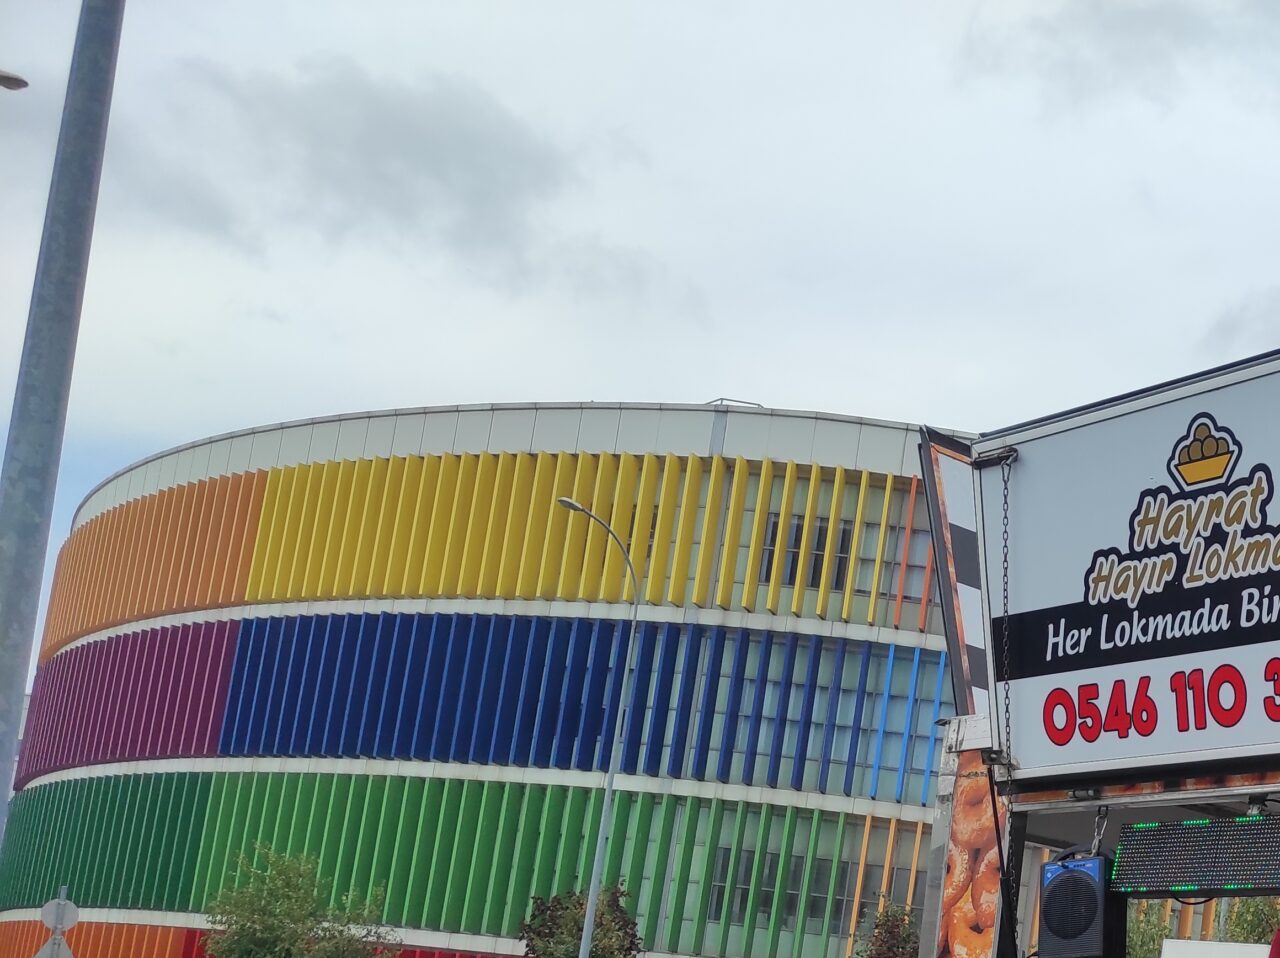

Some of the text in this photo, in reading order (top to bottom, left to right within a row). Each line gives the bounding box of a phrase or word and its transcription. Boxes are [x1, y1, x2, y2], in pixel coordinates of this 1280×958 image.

[1135, 474, 1268, 553] Hayrat
[1088, 557, 1175, 607] Hayır
[1046, 618, 1092, 661] Her
[1100, 598, 1231, 650] Lokmada
[1043, 676, 1158, 746] 0546
[1170, 663, 1247, 733] 110
